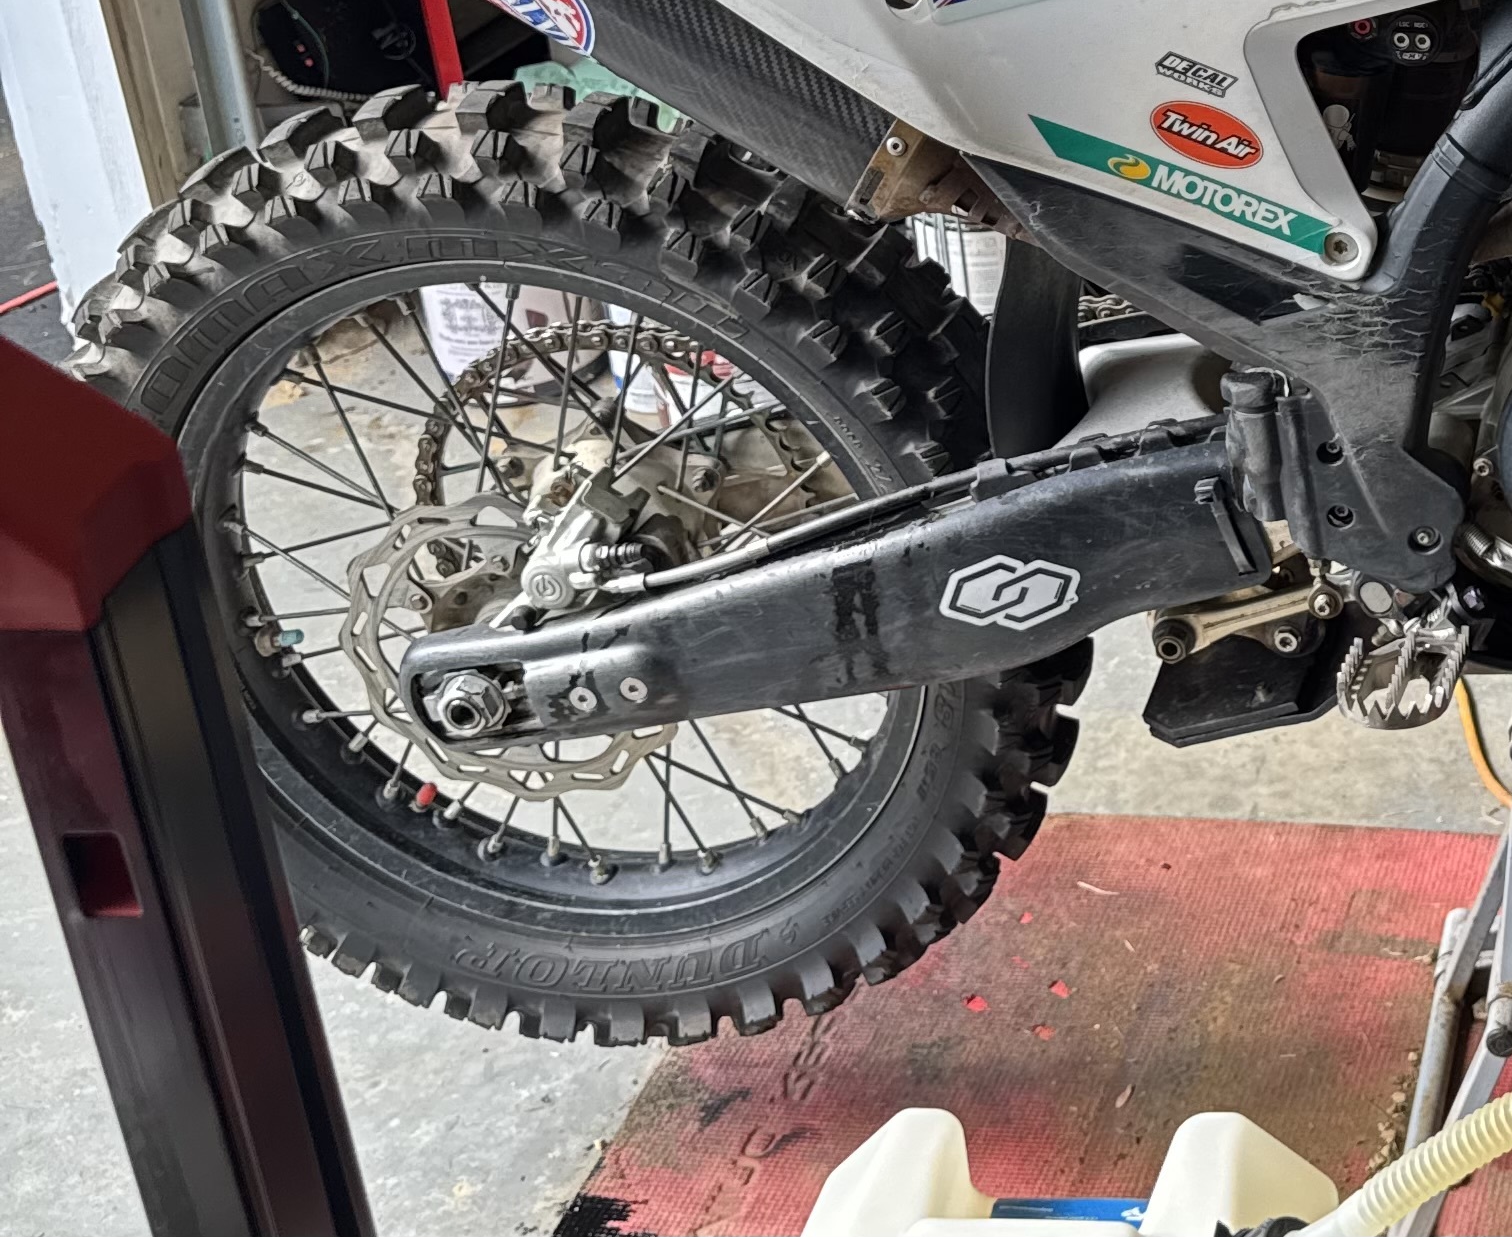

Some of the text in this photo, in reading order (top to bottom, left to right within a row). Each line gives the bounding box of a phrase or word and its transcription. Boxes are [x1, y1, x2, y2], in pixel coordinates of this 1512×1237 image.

[1160, 53, 1235, 91] DECAL
[1158, 109, 1258, 160] Twin Air
[1152, 165, 1298, 237] MOTOREX
[453, 930, 775, 994] DUNLOP
